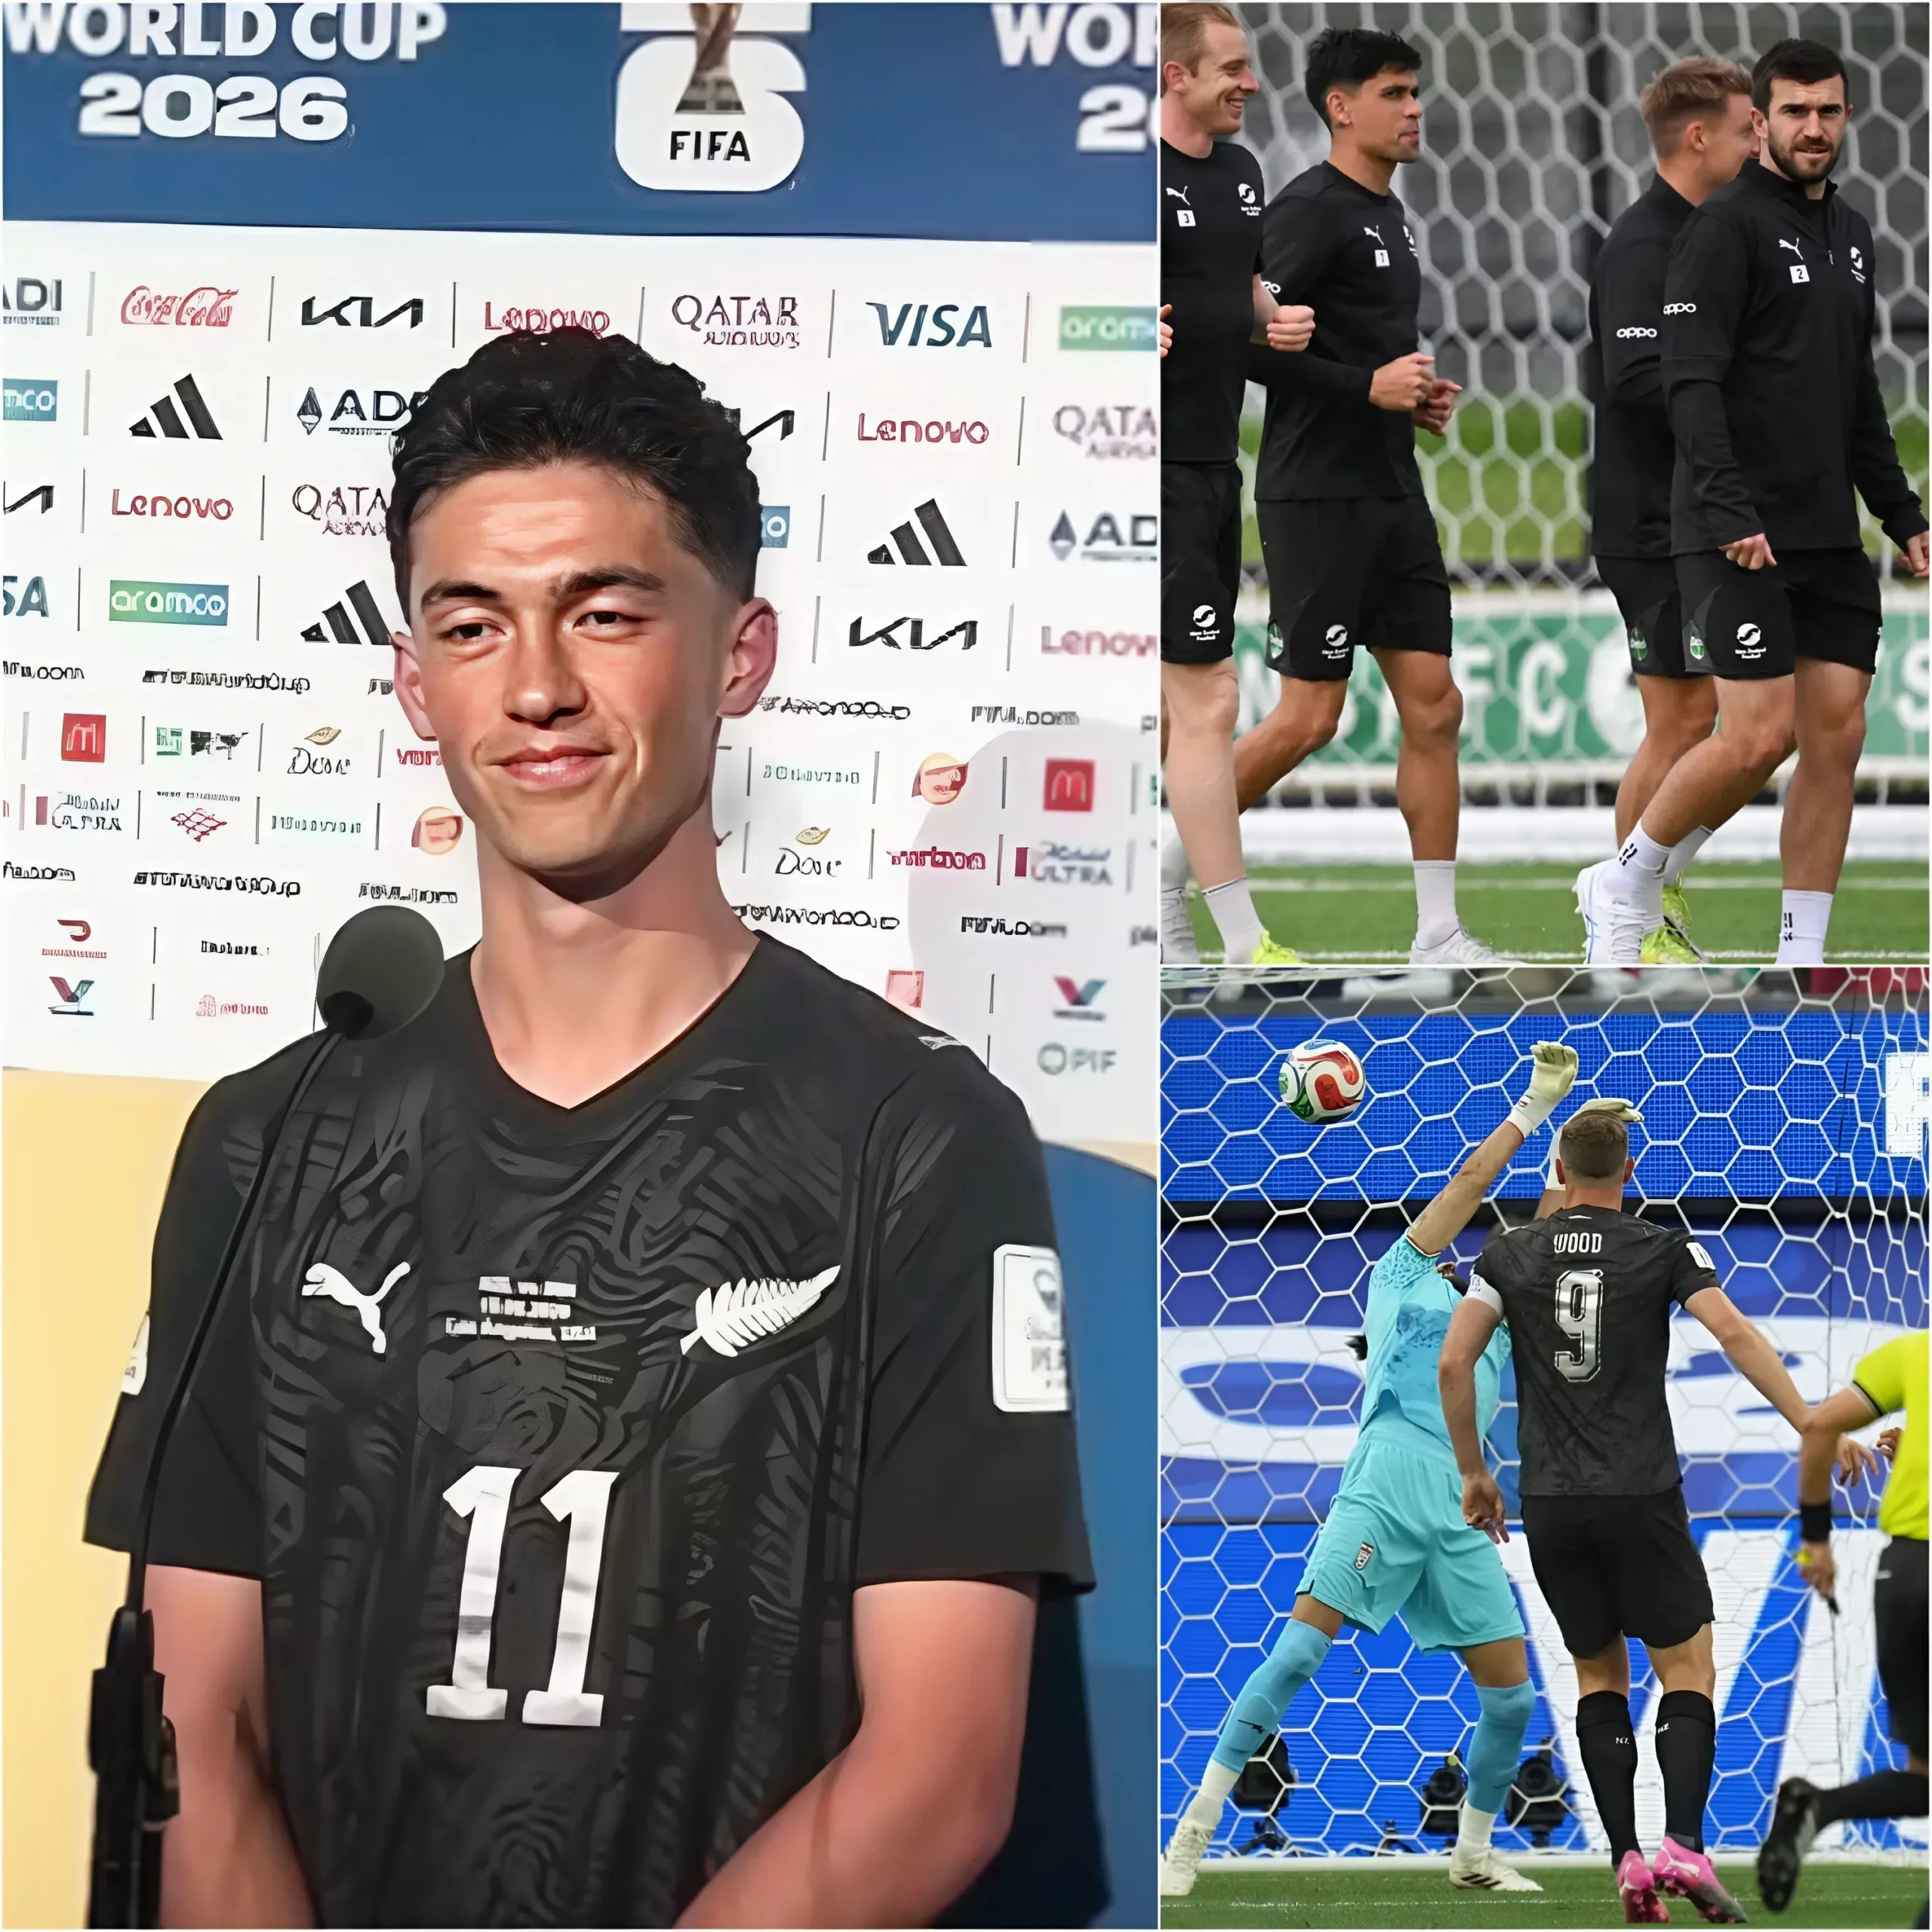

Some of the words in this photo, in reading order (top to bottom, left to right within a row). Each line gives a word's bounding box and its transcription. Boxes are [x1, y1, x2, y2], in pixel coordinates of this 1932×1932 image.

[6, 2, 277, 57] WORLD
[291, 2, 447, 61] CUP
[78, 73, 348, 141] 2026
[1076, 84, 1158, 152] 2
[669, 131, 751, 162] FIFA
[672, 295, 799, 332] QATAR
[865, 301, 992, 348] VISA
[1617, 327, 1657, 339] oppo
[857, 413, 989, 445] Lenovo
[112, 489, 233, 521] Lenovo
[110, 589, 226, 617] aramco
[1553, 1232, 1603, 1254] WOOD
[1554, 1269, 1604, 1383] 9
[426, 1465, 620, 1727] 11
